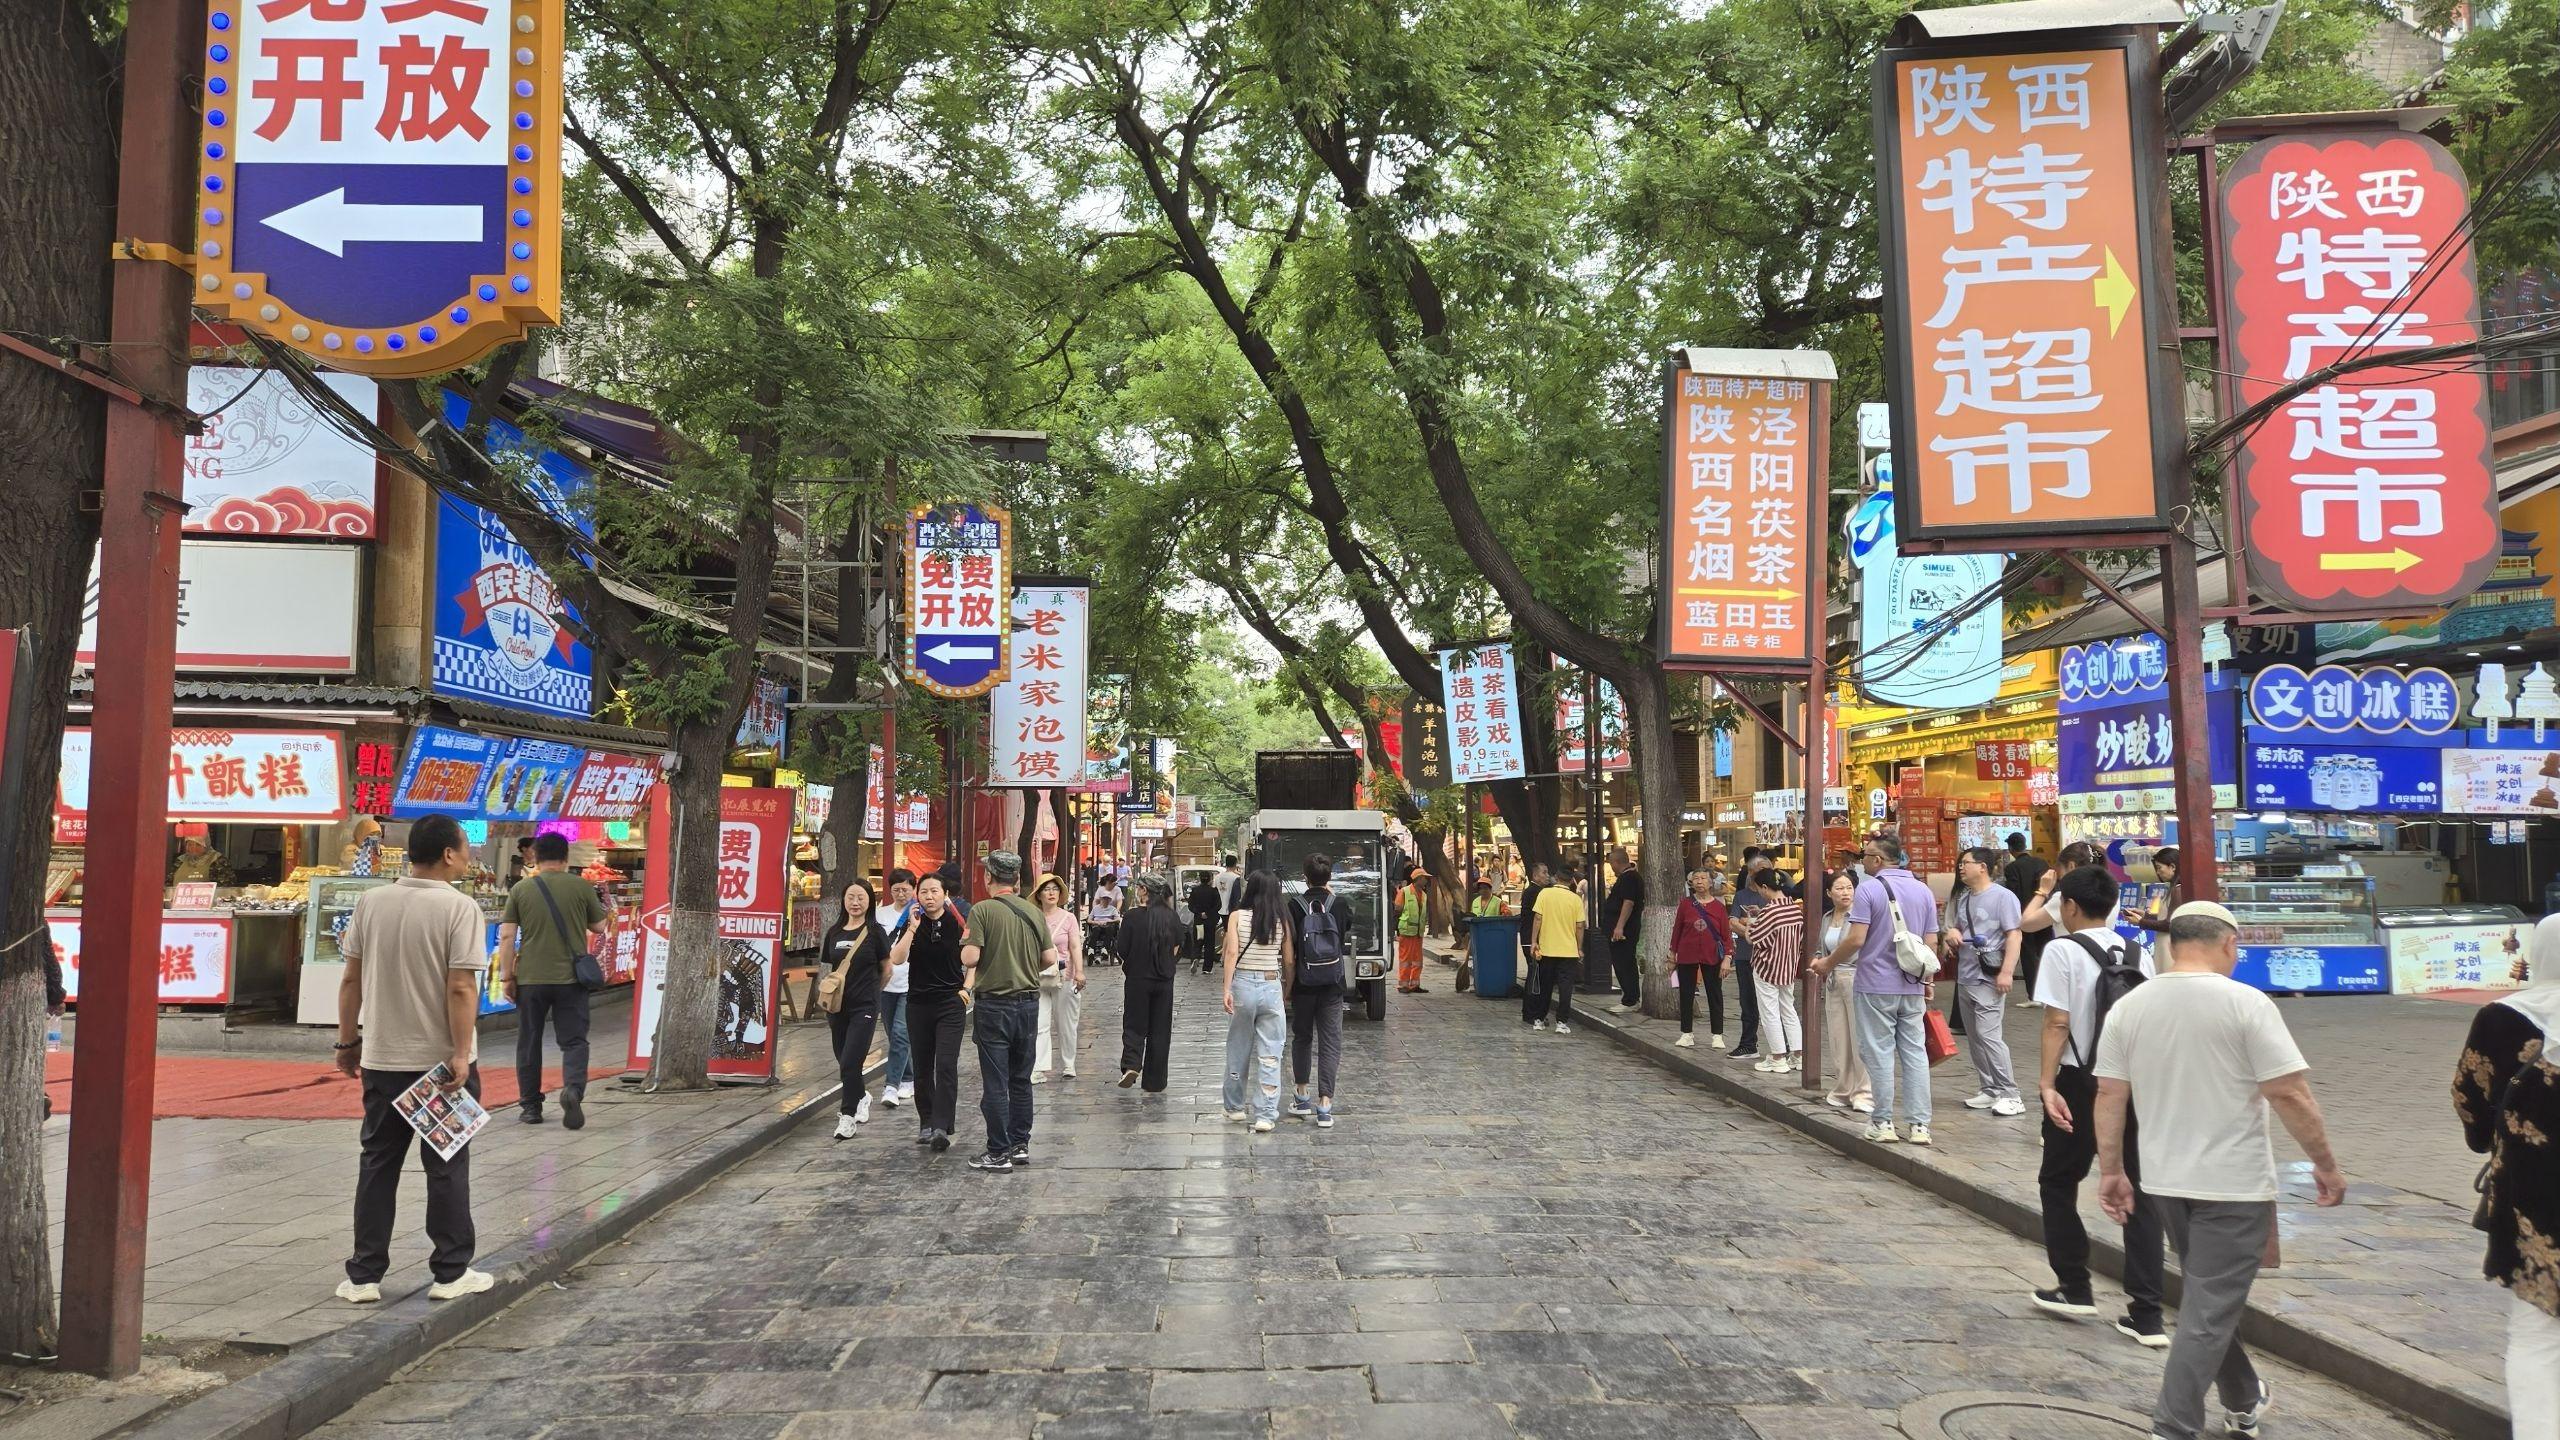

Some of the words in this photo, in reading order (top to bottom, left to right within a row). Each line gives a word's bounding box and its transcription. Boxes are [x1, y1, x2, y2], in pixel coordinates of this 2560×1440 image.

[252, 34, 491, 143] 开放
[1910, 62, 2093, 137] 陕西
[2270, 168, 2425, 222] 陕西
[1916, 143, 2112, 514] 特产超市
[1684, 376, 1805, 401] 陕西特产超市
[2274, 227, 2447, 541] 特产超市
[1688, 404, 1736, 582] 陕西名烟
[1747, 407, 1797, 585] 泾阳茯茶
[921, 552, 993, 589] 免费
[1892, 568, 1902, 594] TASTE
[1922, 563, 1956, 572] SIMUEL
[920, 593, 995, 627] 开放
[1684, 601, 1795, 630] 蓝田玉
[1701, 632, 1782, 649] 正品专柜
[2064, 640, 2163, 691] 文创冰糕
[1011, 609, 1065, 779] 老米家泡馍
[1480, 649, 1512, 744] 喝茶看戏
[2263, 679, 2449, 722] 文创冰糕
[1457, 759, 1519, 776] 请上二楼
[1976, 744, 1999, 762] 喝茶
[2005, 743, 2030, 761] 看戏
[2256, 747, 2304, 763] 希木尔
[2496, 763, 2522, 775] 陕派
[1992, 763, 2025, 777] 9.9元
[2495, 778, 2522, 789] 文创
[720, 798, 778, 813] 忆展览馆
